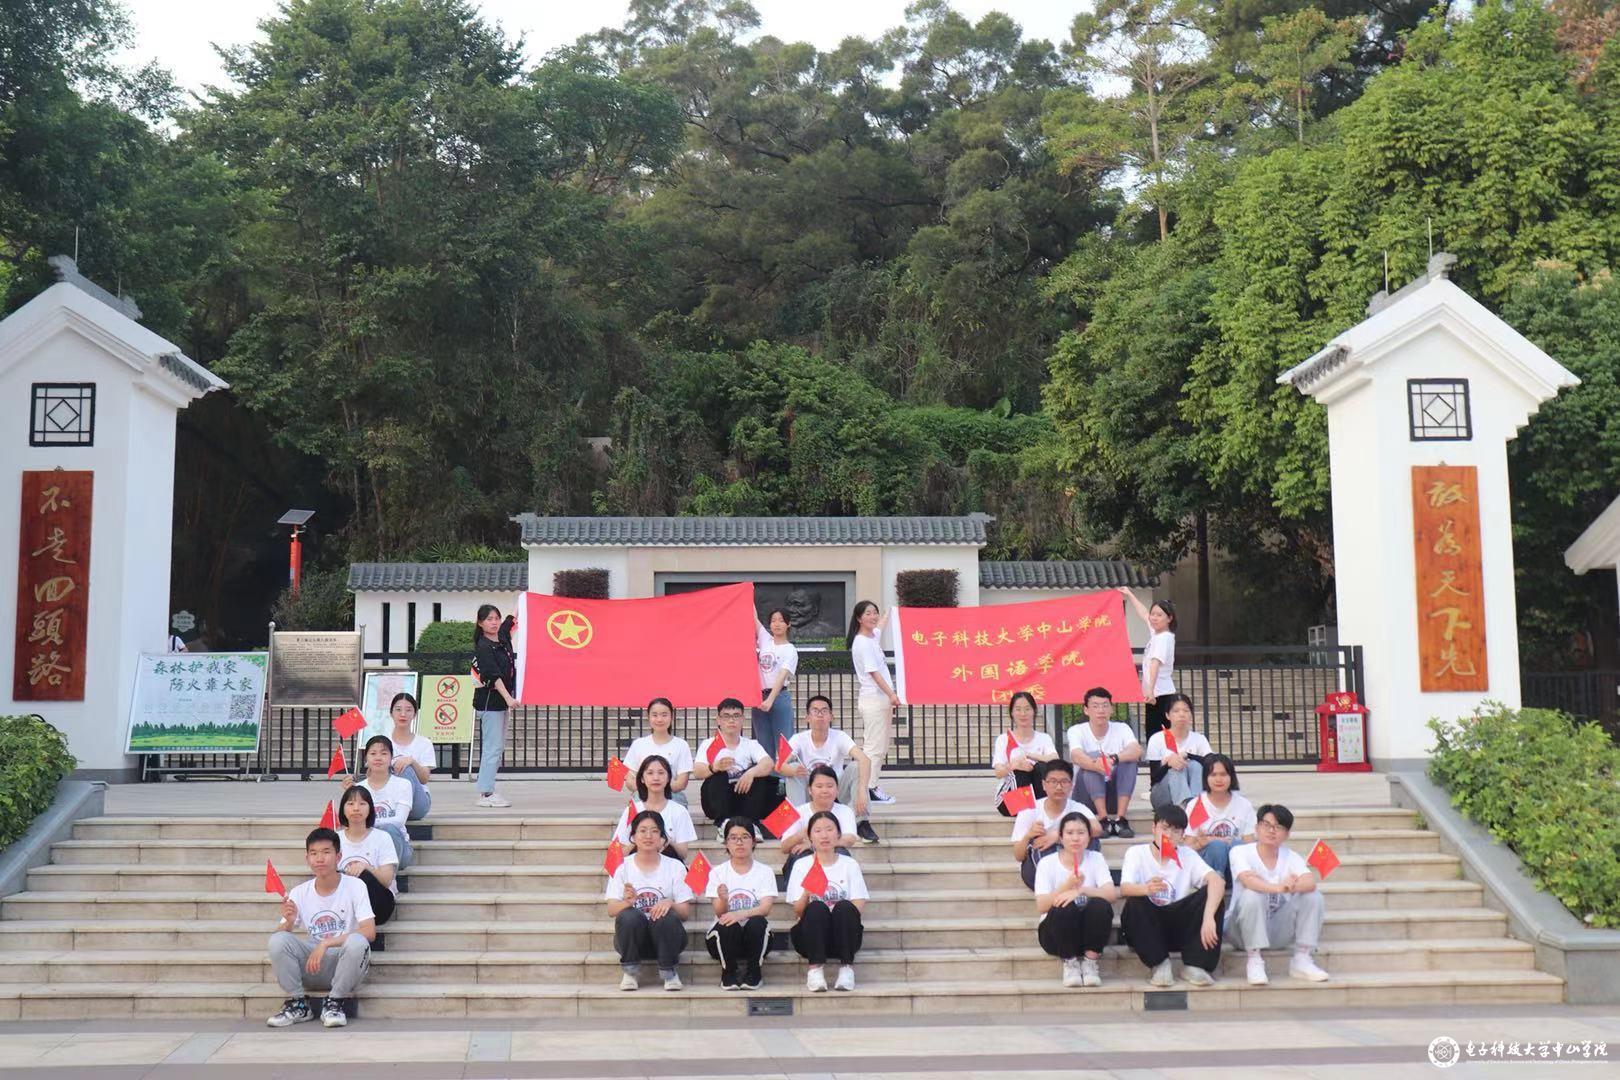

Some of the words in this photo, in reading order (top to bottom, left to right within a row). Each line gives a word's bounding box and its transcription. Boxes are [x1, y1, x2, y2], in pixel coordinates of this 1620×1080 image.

[911, 614, 1112, 648] 电子科技大学中山学院
[153, 660, 238, 675] 森林护我家
[951, 651, 1085, 682] 外国语学院
[170, 677, 253, 692] 防火靠大家
